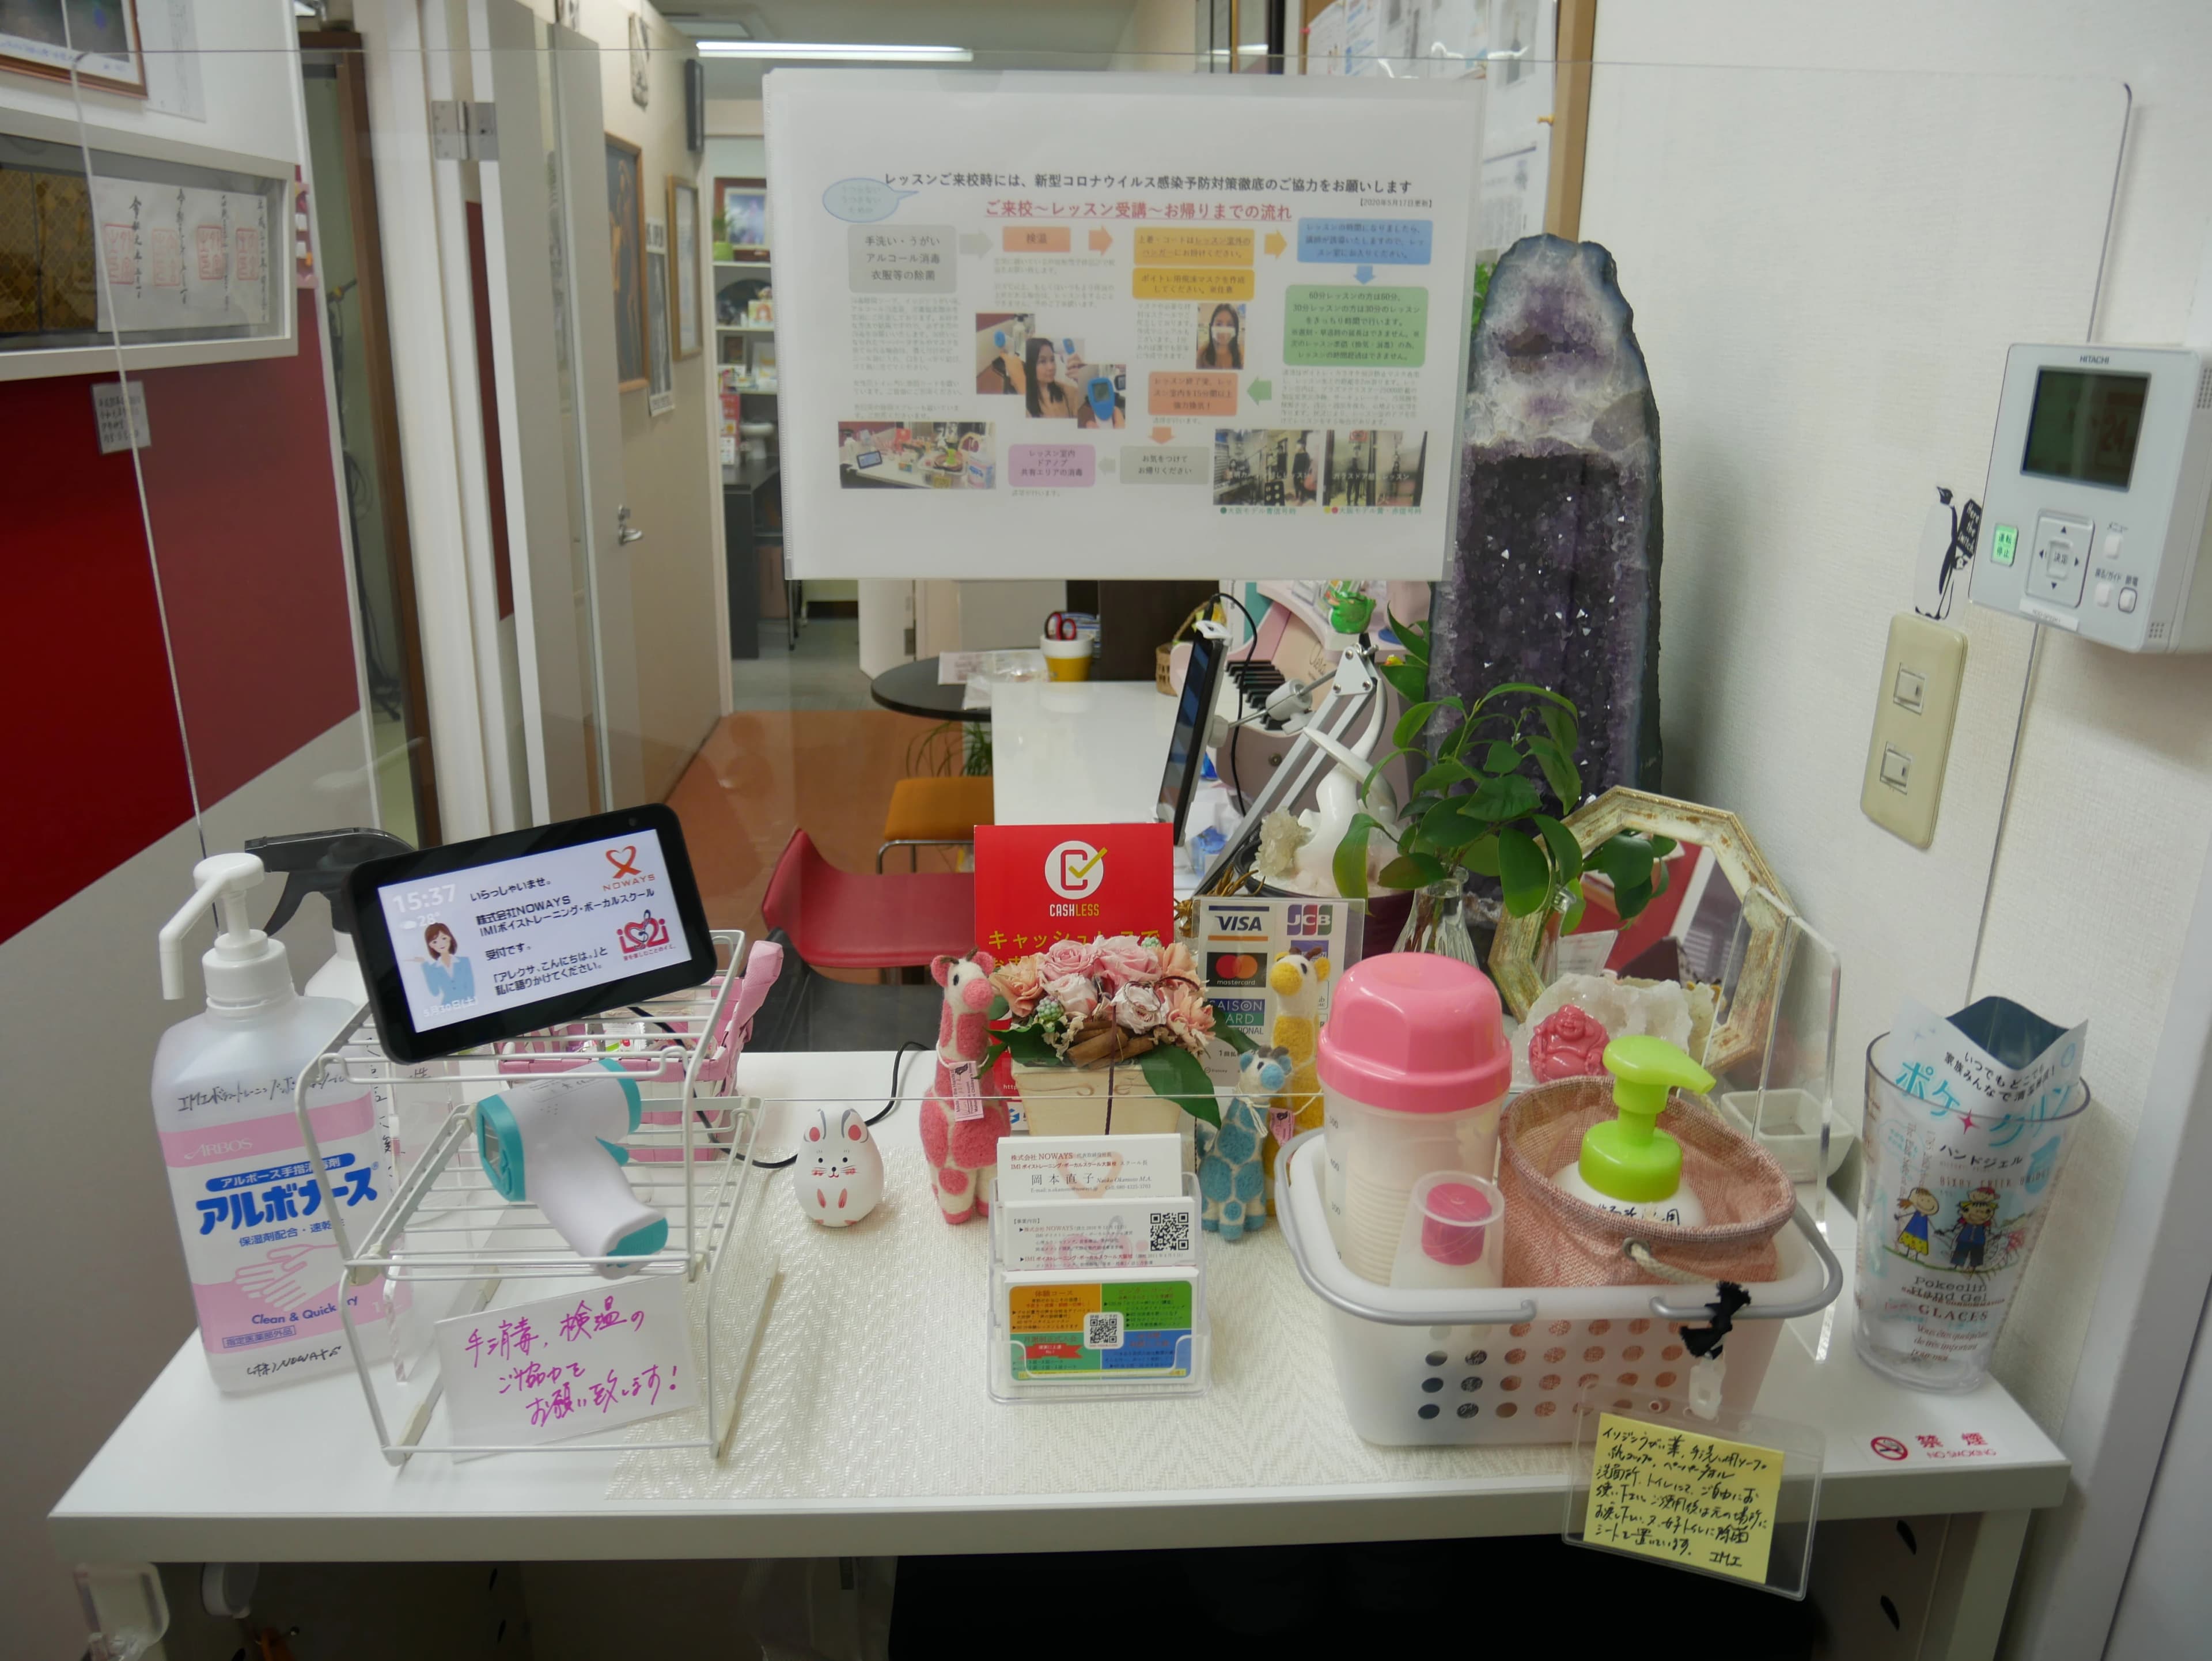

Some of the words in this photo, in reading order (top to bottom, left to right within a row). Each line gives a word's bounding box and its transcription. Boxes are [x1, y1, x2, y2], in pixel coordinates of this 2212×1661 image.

[885, 172, 1412, 194] レッスンご来校時には、新型コロナウイルス感染予防対策徹底のご協力をお願いします
[865, 235, 941, 247] 手洗い・うがい
[866, 253, 941, 264] アルコール消毒
[870, 270, 935, 281] 衣服等の除菌
[2080, 355, 2109, 364] HITACHI
[470, 877, 551, 902] いらっしゃいませ。
[603, 873, 656, 892] NOWAYS
[393, 884, 456, 913] 15:37
[476, 895, 571, 926] 株式会社NOWAYS
[1049, 903, 1100, 917] CASHLESS
[1215, 915, 1262, 932] VISA
[988, 929, 1160, 950] キャッシュ
[485, 943, 533, 962] 受付です。
[493, 945, 609, 984] 「アレクサ、こんにちは。」と
[495, 962, 603, 997] 私に語りかけてください。
[1225, 1013, 1255, 1024] ARD
[184, 1137, 253, 1160] ARBOS
[1038, 1152, 1074, 1160] NOWAYS
[1940, 1144, 2024, 1169] ハンドジェル
[196, 1167, 378, 1235] アルボナース
[240, 1218, 346, 1247] 保湿剤配合・速乾
[252, 1314, 286, 1325] Clean
[289, 1312, 299, 1322] &
[302, 1303, 337, 1319] Quick
[1918, 1303, 1988, 1322] GLACES
